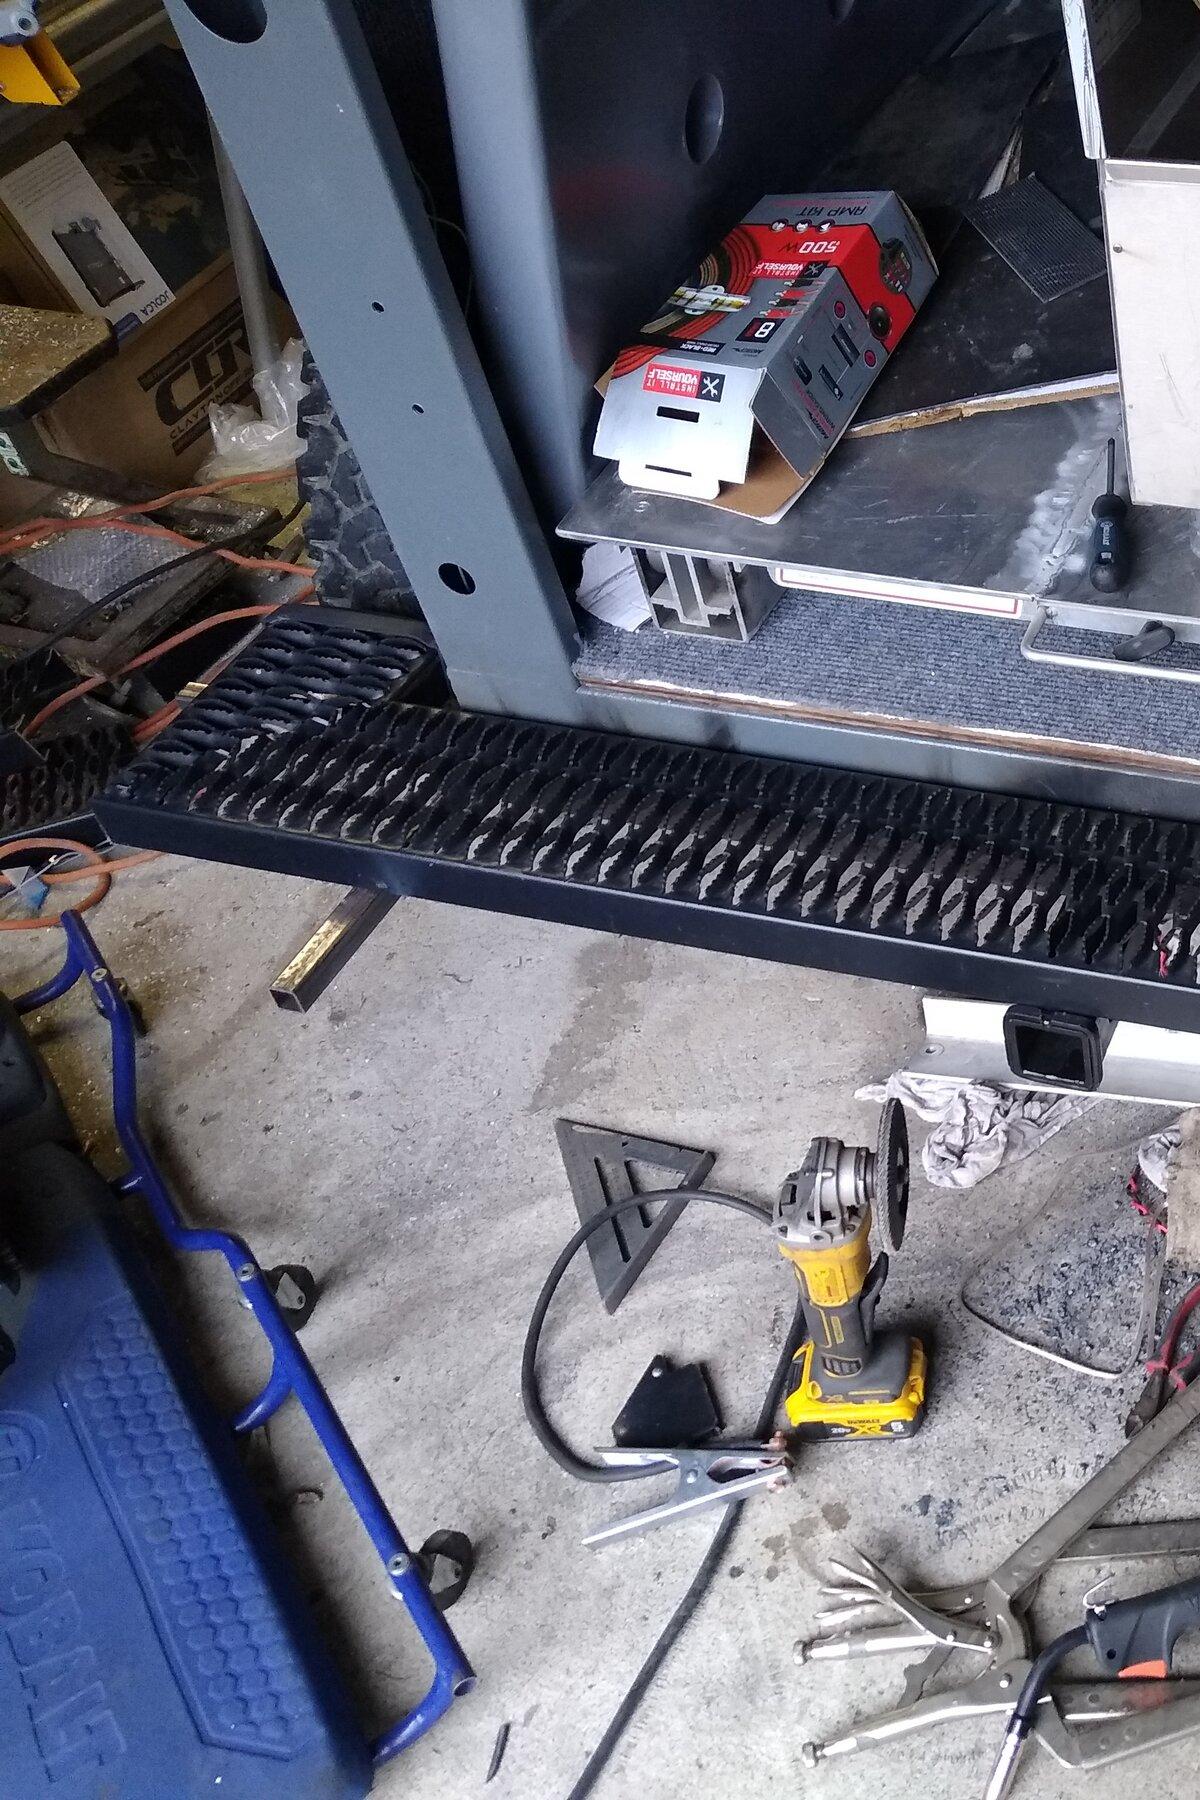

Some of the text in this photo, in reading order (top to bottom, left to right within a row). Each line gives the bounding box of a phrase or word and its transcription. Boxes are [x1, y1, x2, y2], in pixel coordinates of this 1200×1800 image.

[754, 261, 804, 272] YOURSELF
[140, 291, 170, 317] JOOLCA
[647, 367, 699, 385] YOURSELF
[646, 379, 697, 393] INSTALL IT
